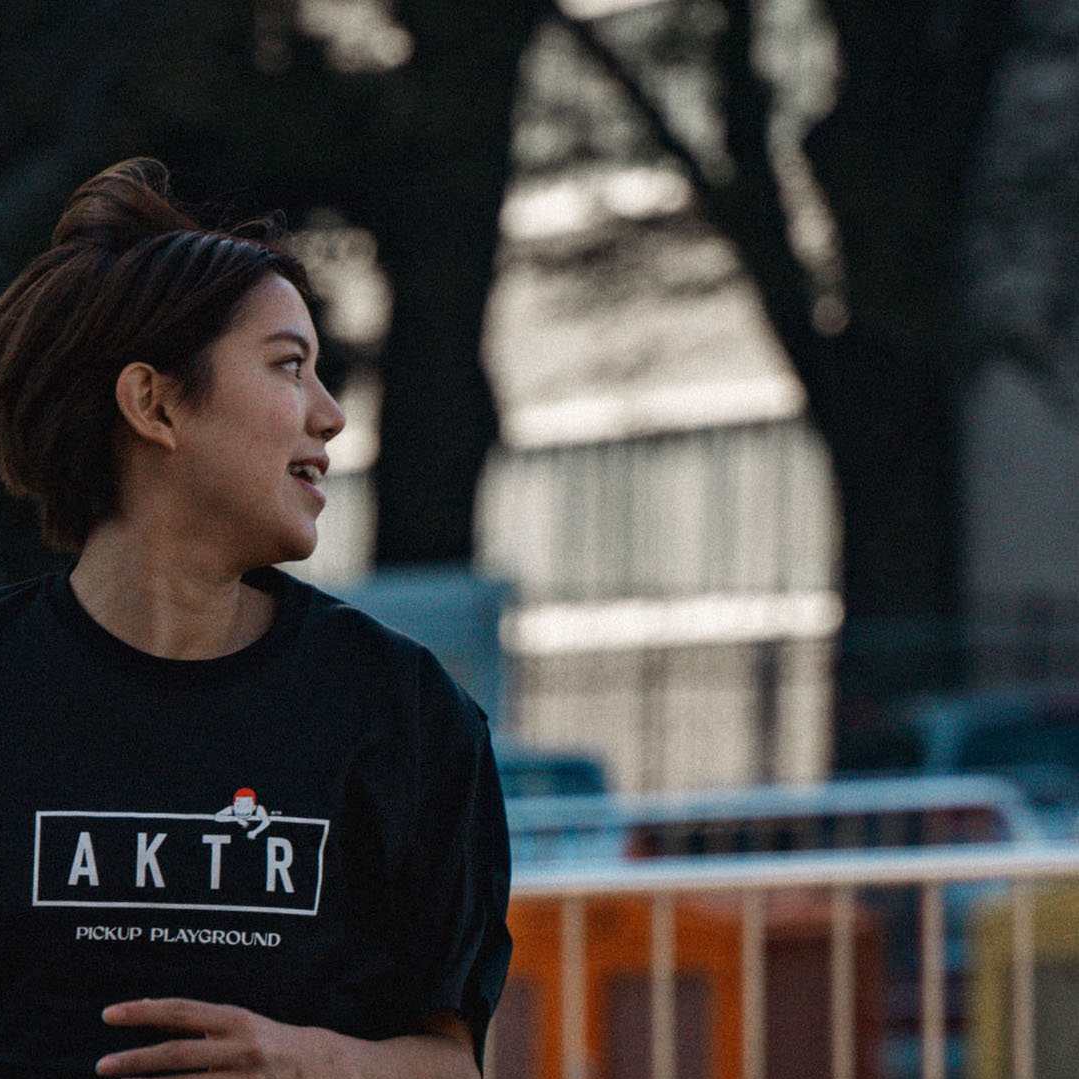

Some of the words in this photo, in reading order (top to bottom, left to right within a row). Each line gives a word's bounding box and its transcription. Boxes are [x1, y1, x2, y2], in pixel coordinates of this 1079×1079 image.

[67, 831, 295, 893] AKTR
[76, 925, 142, 941] PICKUP
[150, 927, 281, 947] PLAYGROUND
